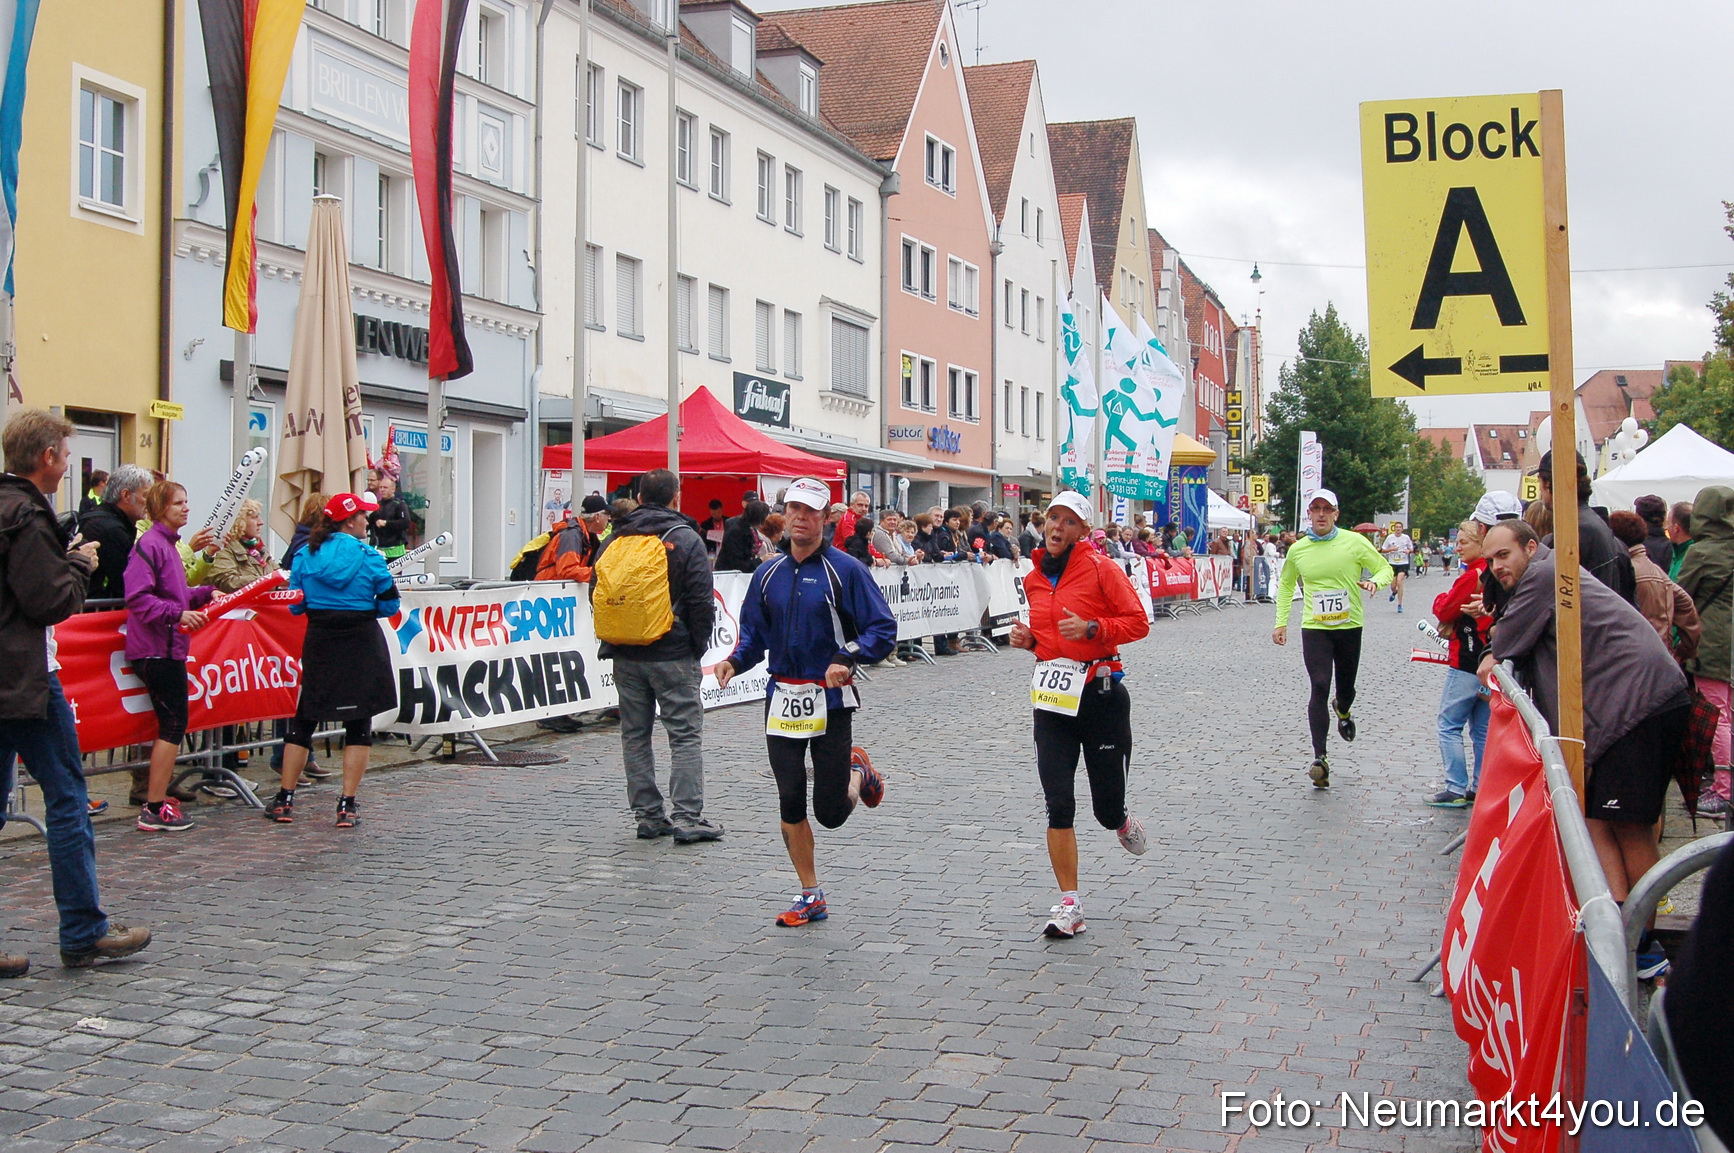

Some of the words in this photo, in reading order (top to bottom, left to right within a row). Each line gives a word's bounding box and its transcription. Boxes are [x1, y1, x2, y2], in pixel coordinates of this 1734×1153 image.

[319, 63, 388, 119] BRILLEN
[1384, 107, 1541, 164] Block
[1410, 186, 1528, 330] A
[140, 433, 152, 448] 24
[395, 430, 424, 448] BRILLEN
[1227, 392, 1241, 473] HOTEL
[1254, 484, 1264, 497] B
[1527, 485, 1537, 499] B
[932, 603, 960, 618] Fahrfreude.
[1319, 598, 1343, 612] 175
[424, 596, 577, 653] INTERSPORT
[1051, 661, 1078, 671] Neumarkt
[187, 643, 302, 710] Sparkas
[1039, 669, 1073, 692] 185
[394, 650, 591, 725] HACKNER
[781, 697, 814, 718] 269
[1037, 693, 1058, 704] Karin
[780, 722, 813, 730] Christine
